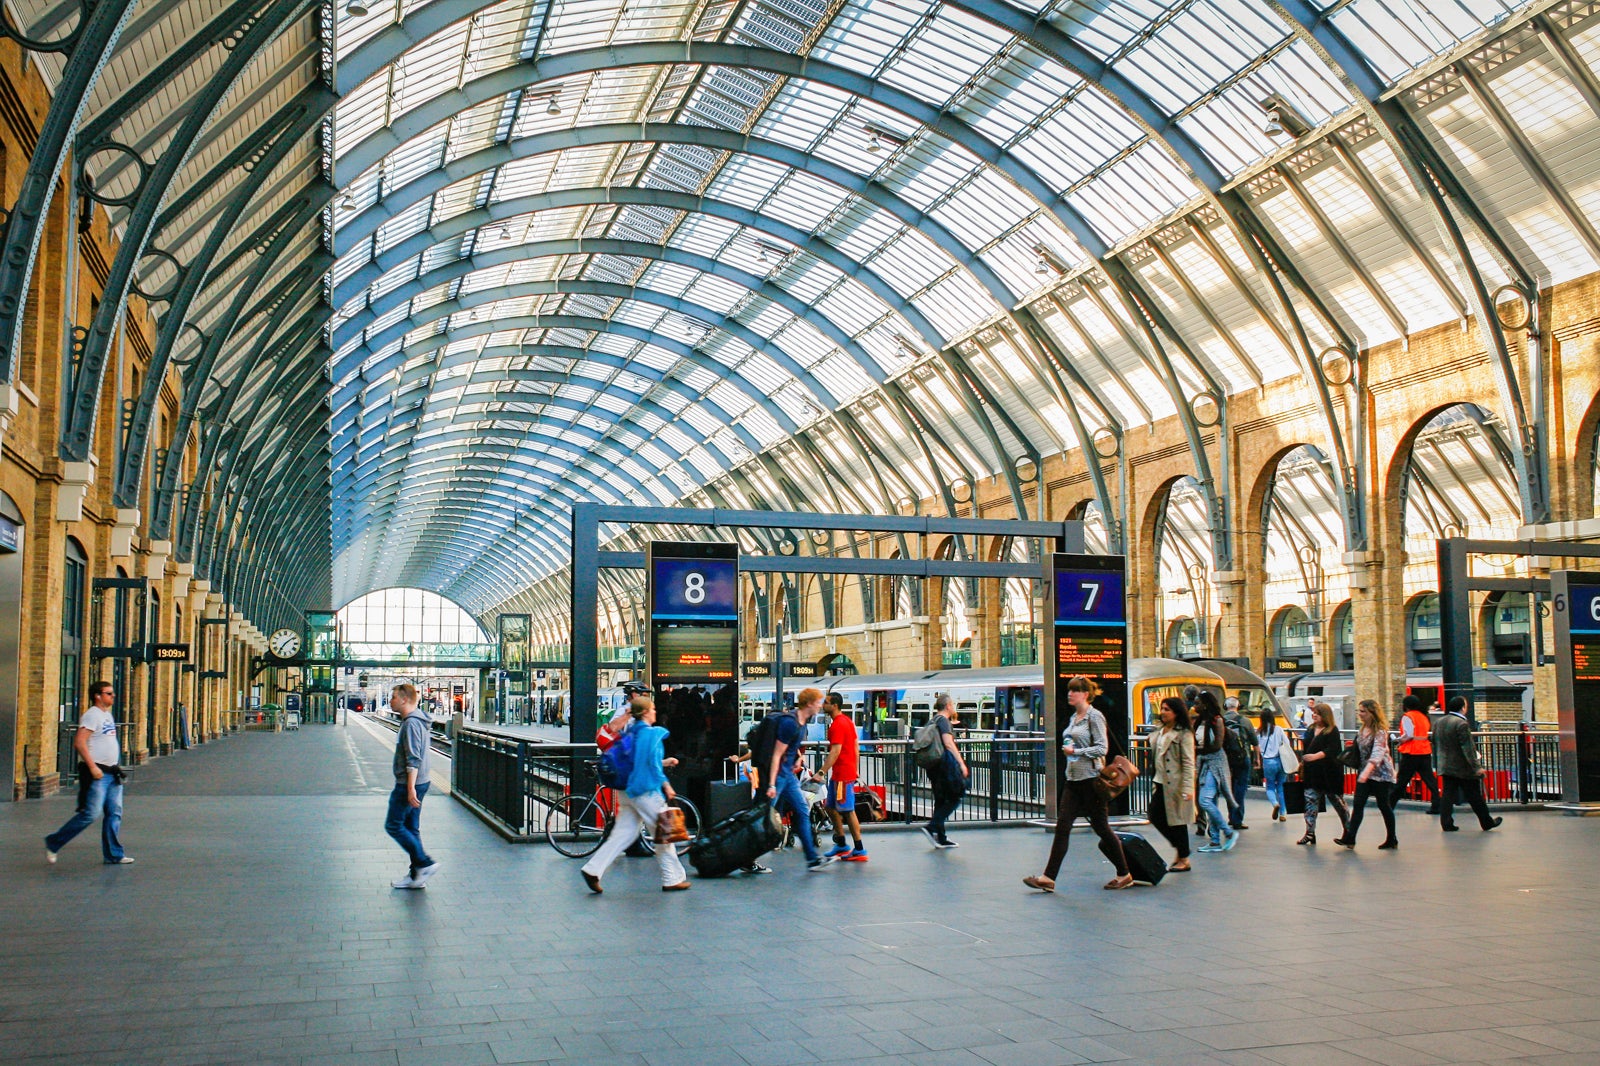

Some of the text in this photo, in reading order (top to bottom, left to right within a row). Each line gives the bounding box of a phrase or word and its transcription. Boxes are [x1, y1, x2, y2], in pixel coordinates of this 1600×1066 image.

[685, 572, 705, 603] 8
[1044, 581, 1051, 601] 7
[1081, 583, 1099, 611] 7
[1554, 594, 1565, 612] 6
